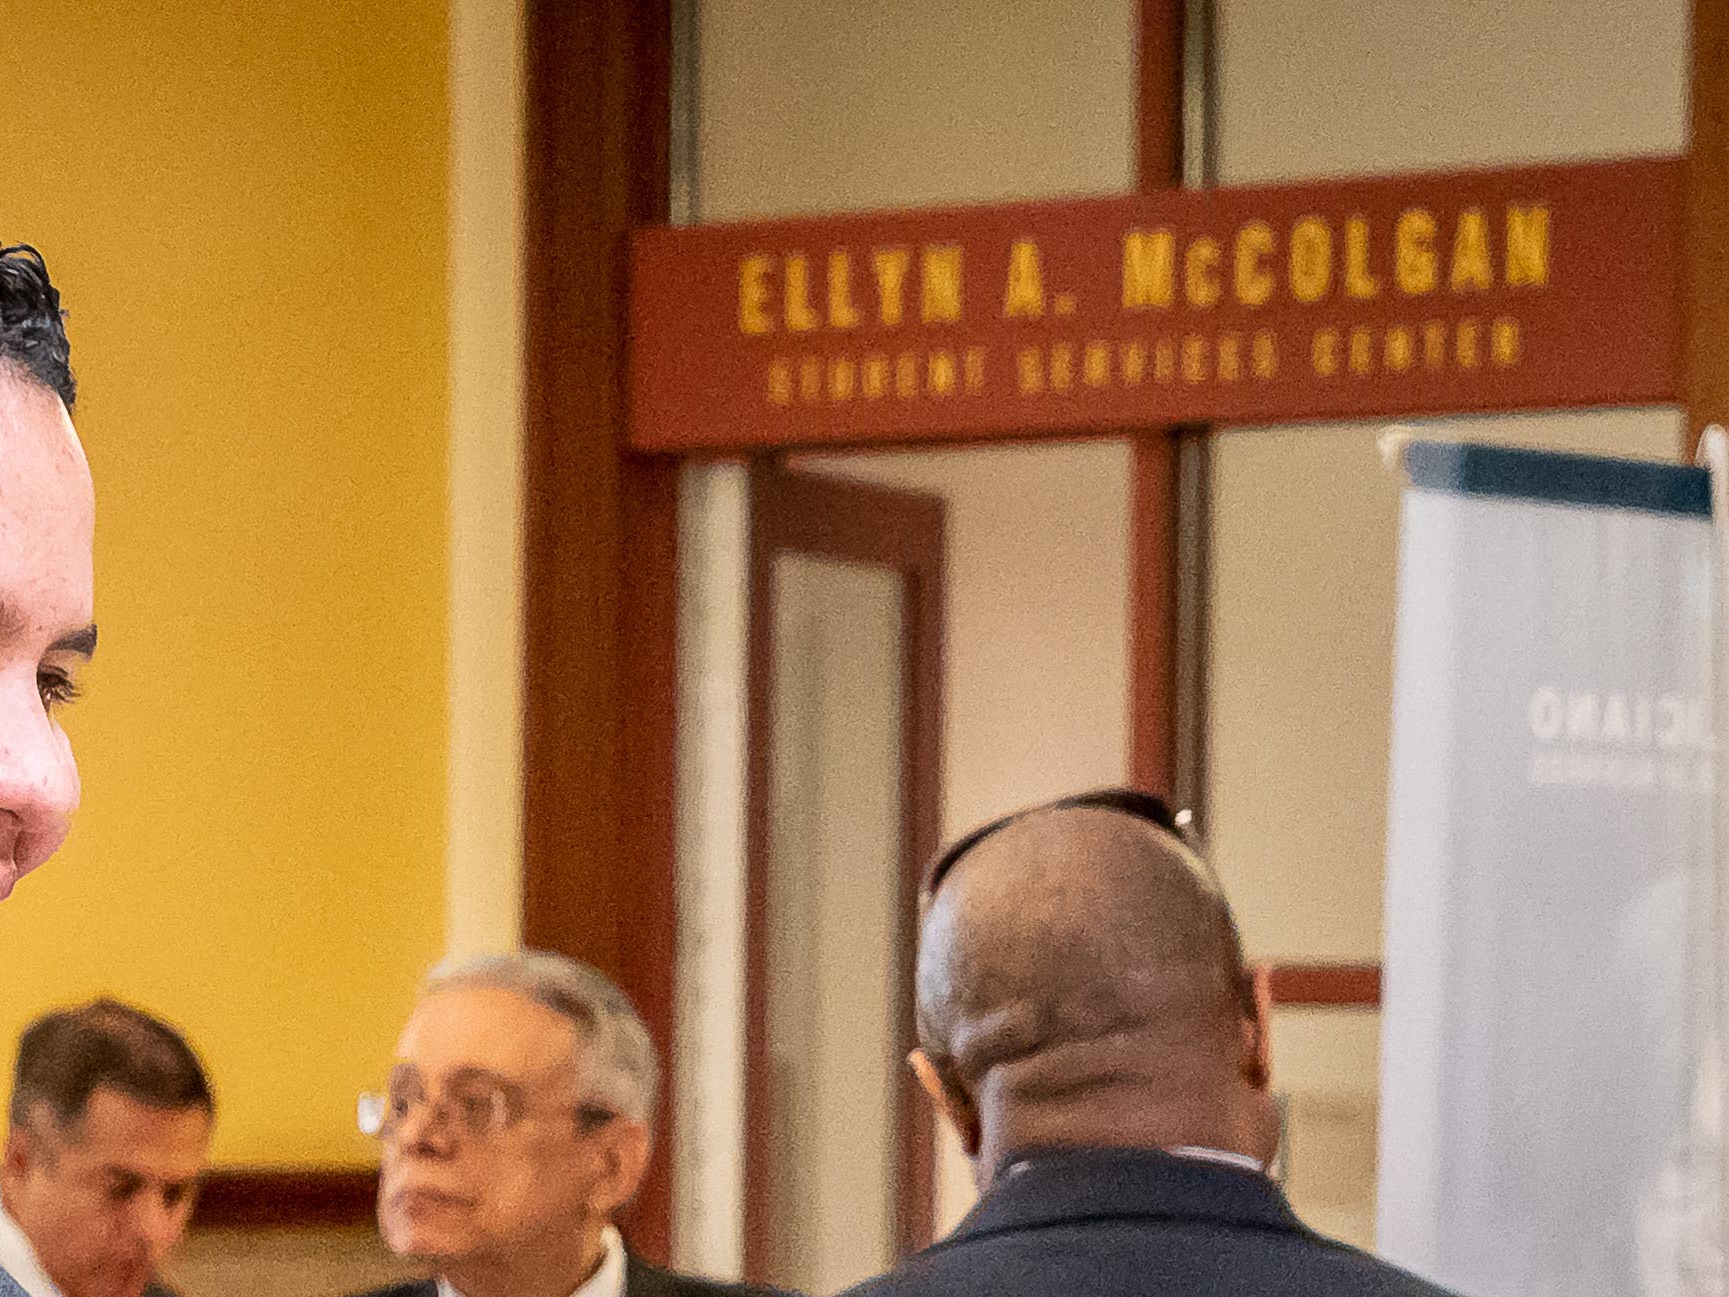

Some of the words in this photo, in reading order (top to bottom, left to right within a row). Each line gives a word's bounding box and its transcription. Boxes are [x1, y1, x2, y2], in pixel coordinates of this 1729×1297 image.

[739, 243, 962, 335] ELLYN
[1005, 239, 1073, 318] A.
[1122, 206, 1549, 310] McCOLGAN
[769, 345, 985, 405] STUDENT
[1016, 329, 1277, 393] SERVICES
[1312, 318, 1520, 377] CENTER
